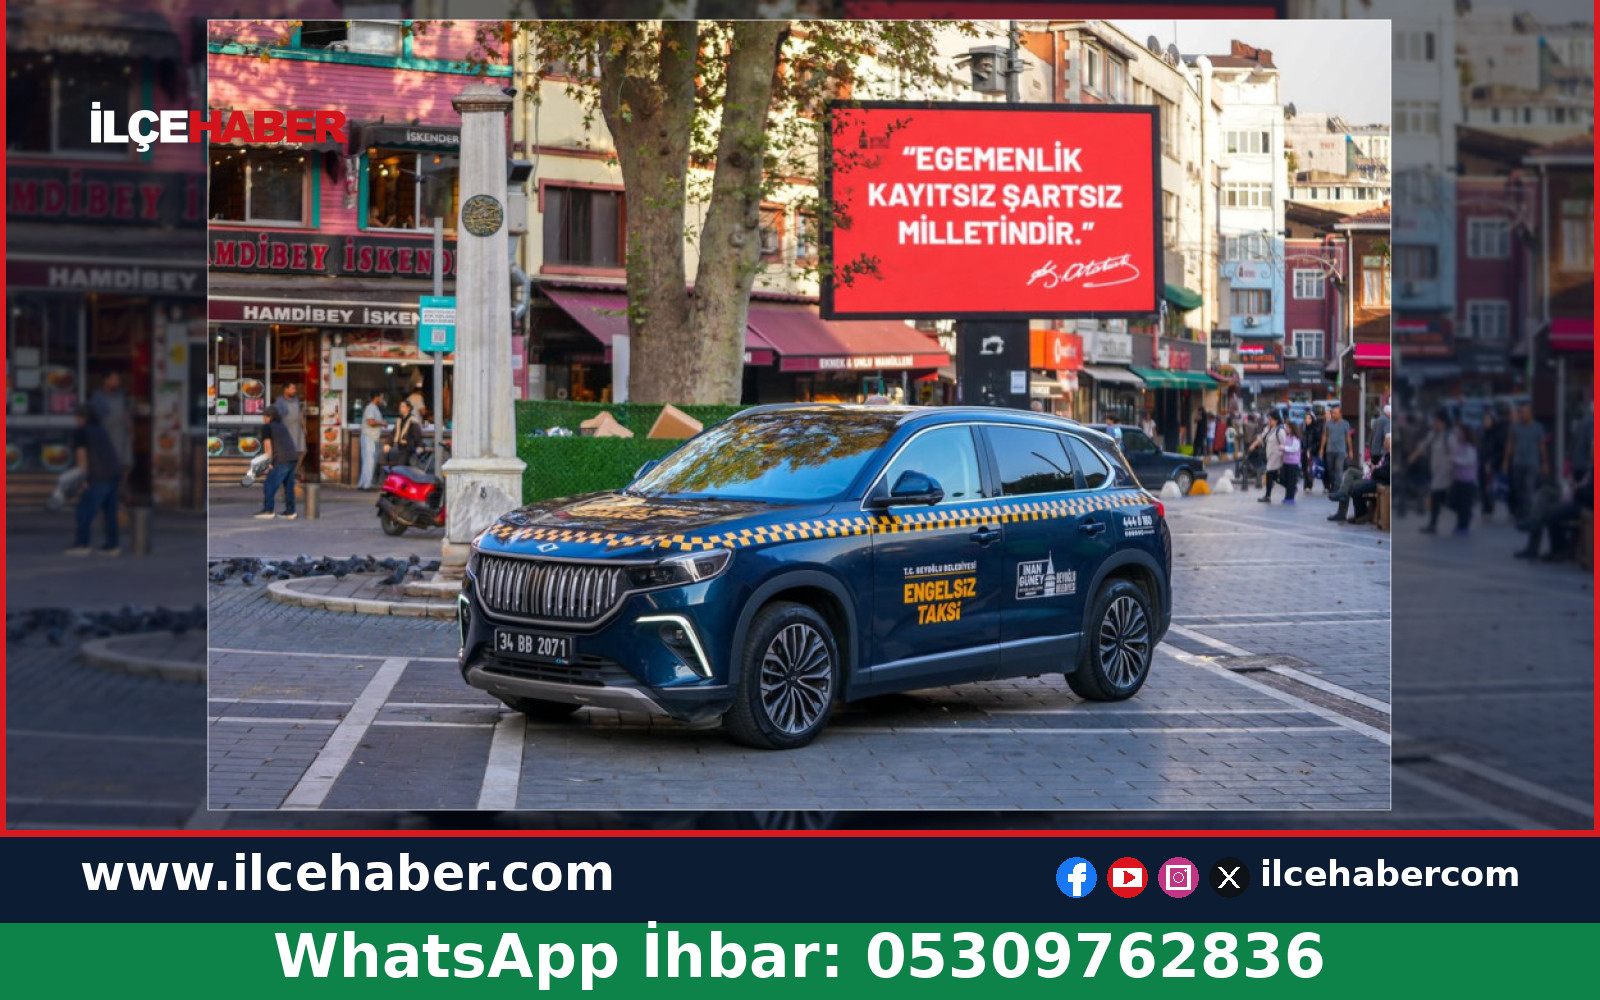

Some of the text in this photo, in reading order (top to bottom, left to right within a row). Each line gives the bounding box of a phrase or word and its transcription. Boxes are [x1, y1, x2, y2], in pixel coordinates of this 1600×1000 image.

[867, 182, 1123, 213] KAYITSIZ ŞARTSIZ
[243, 304, 354, 324] HAMDİBEY
[499, 632, 566, 658] 34 BB 2071
